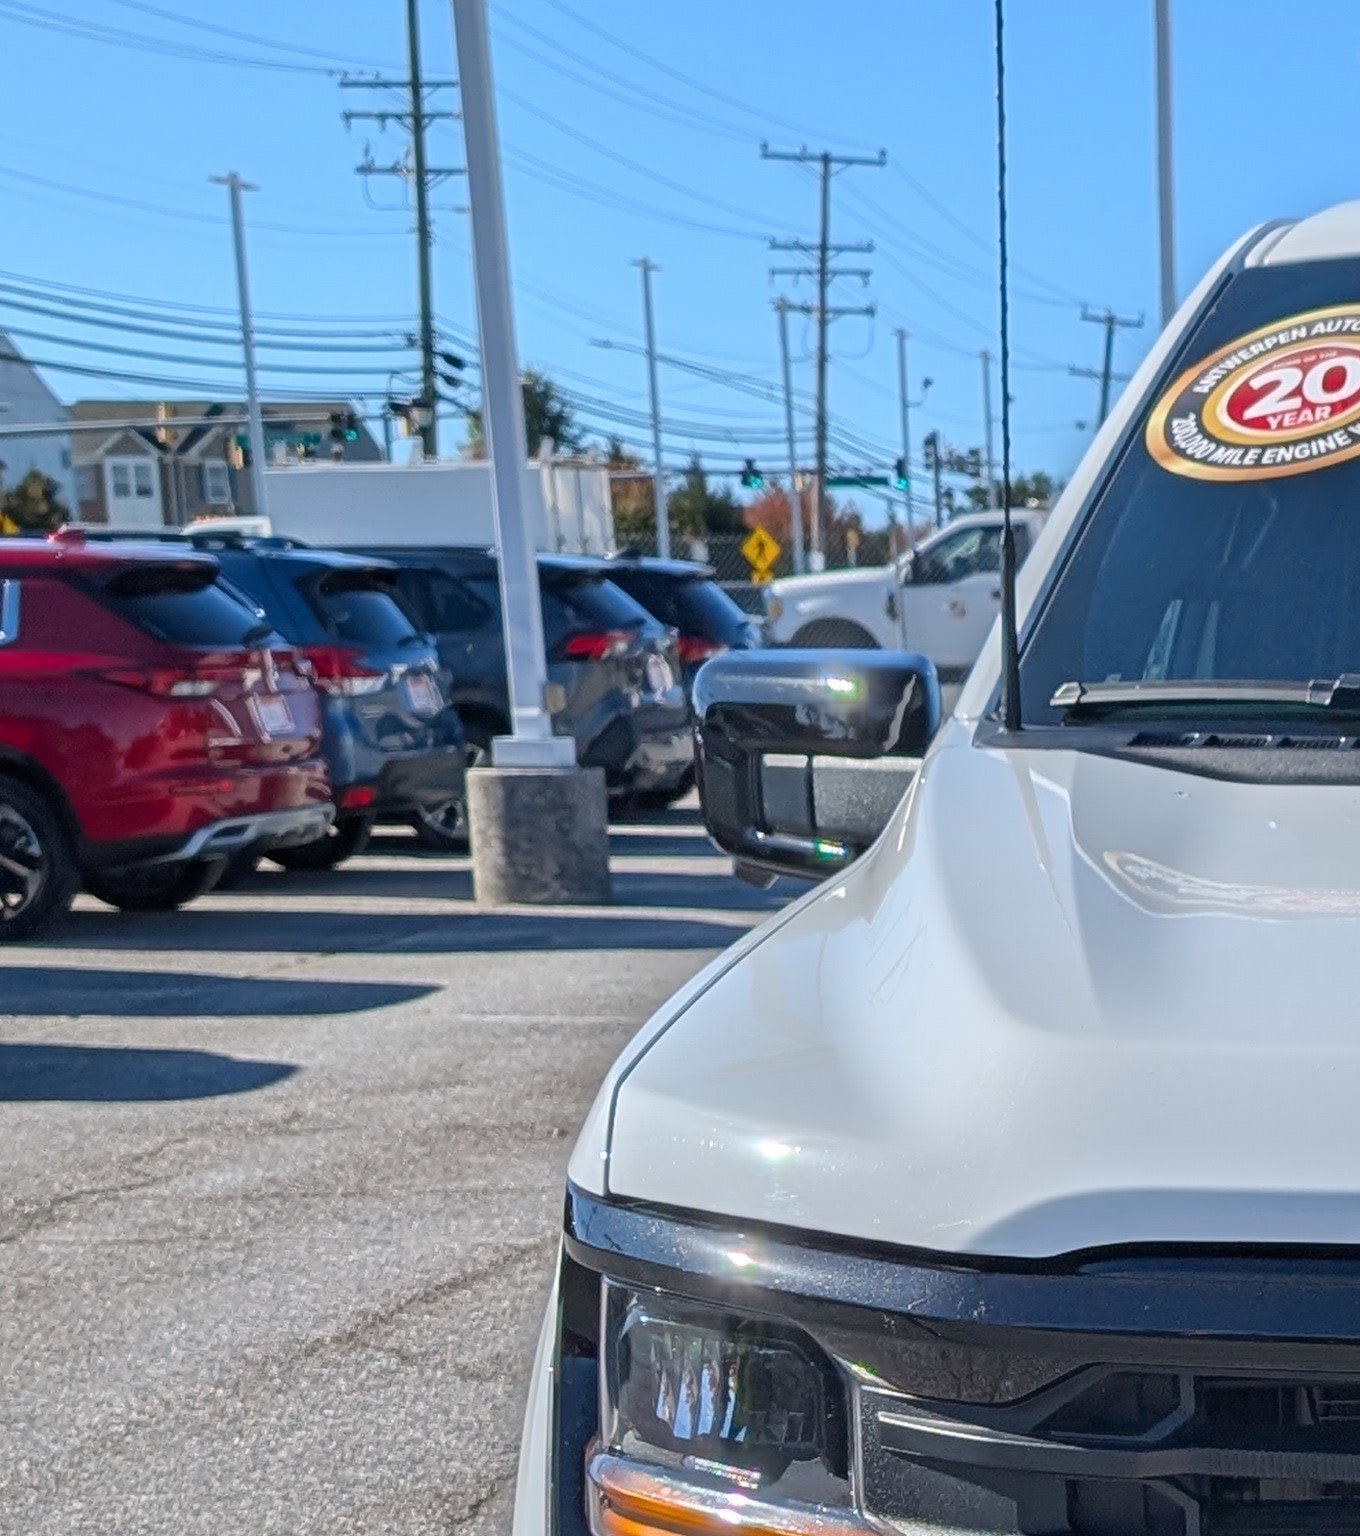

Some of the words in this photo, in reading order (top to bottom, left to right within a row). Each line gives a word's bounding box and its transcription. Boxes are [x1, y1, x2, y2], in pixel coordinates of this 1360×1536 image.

[1192, 325, 1308, 395] ANTWERPEN
[1265, 404, 1332, 430] YEAR
[1207, 446, 1260, 465] MILE
[1261, 429, 1352, 465] ENGINE
